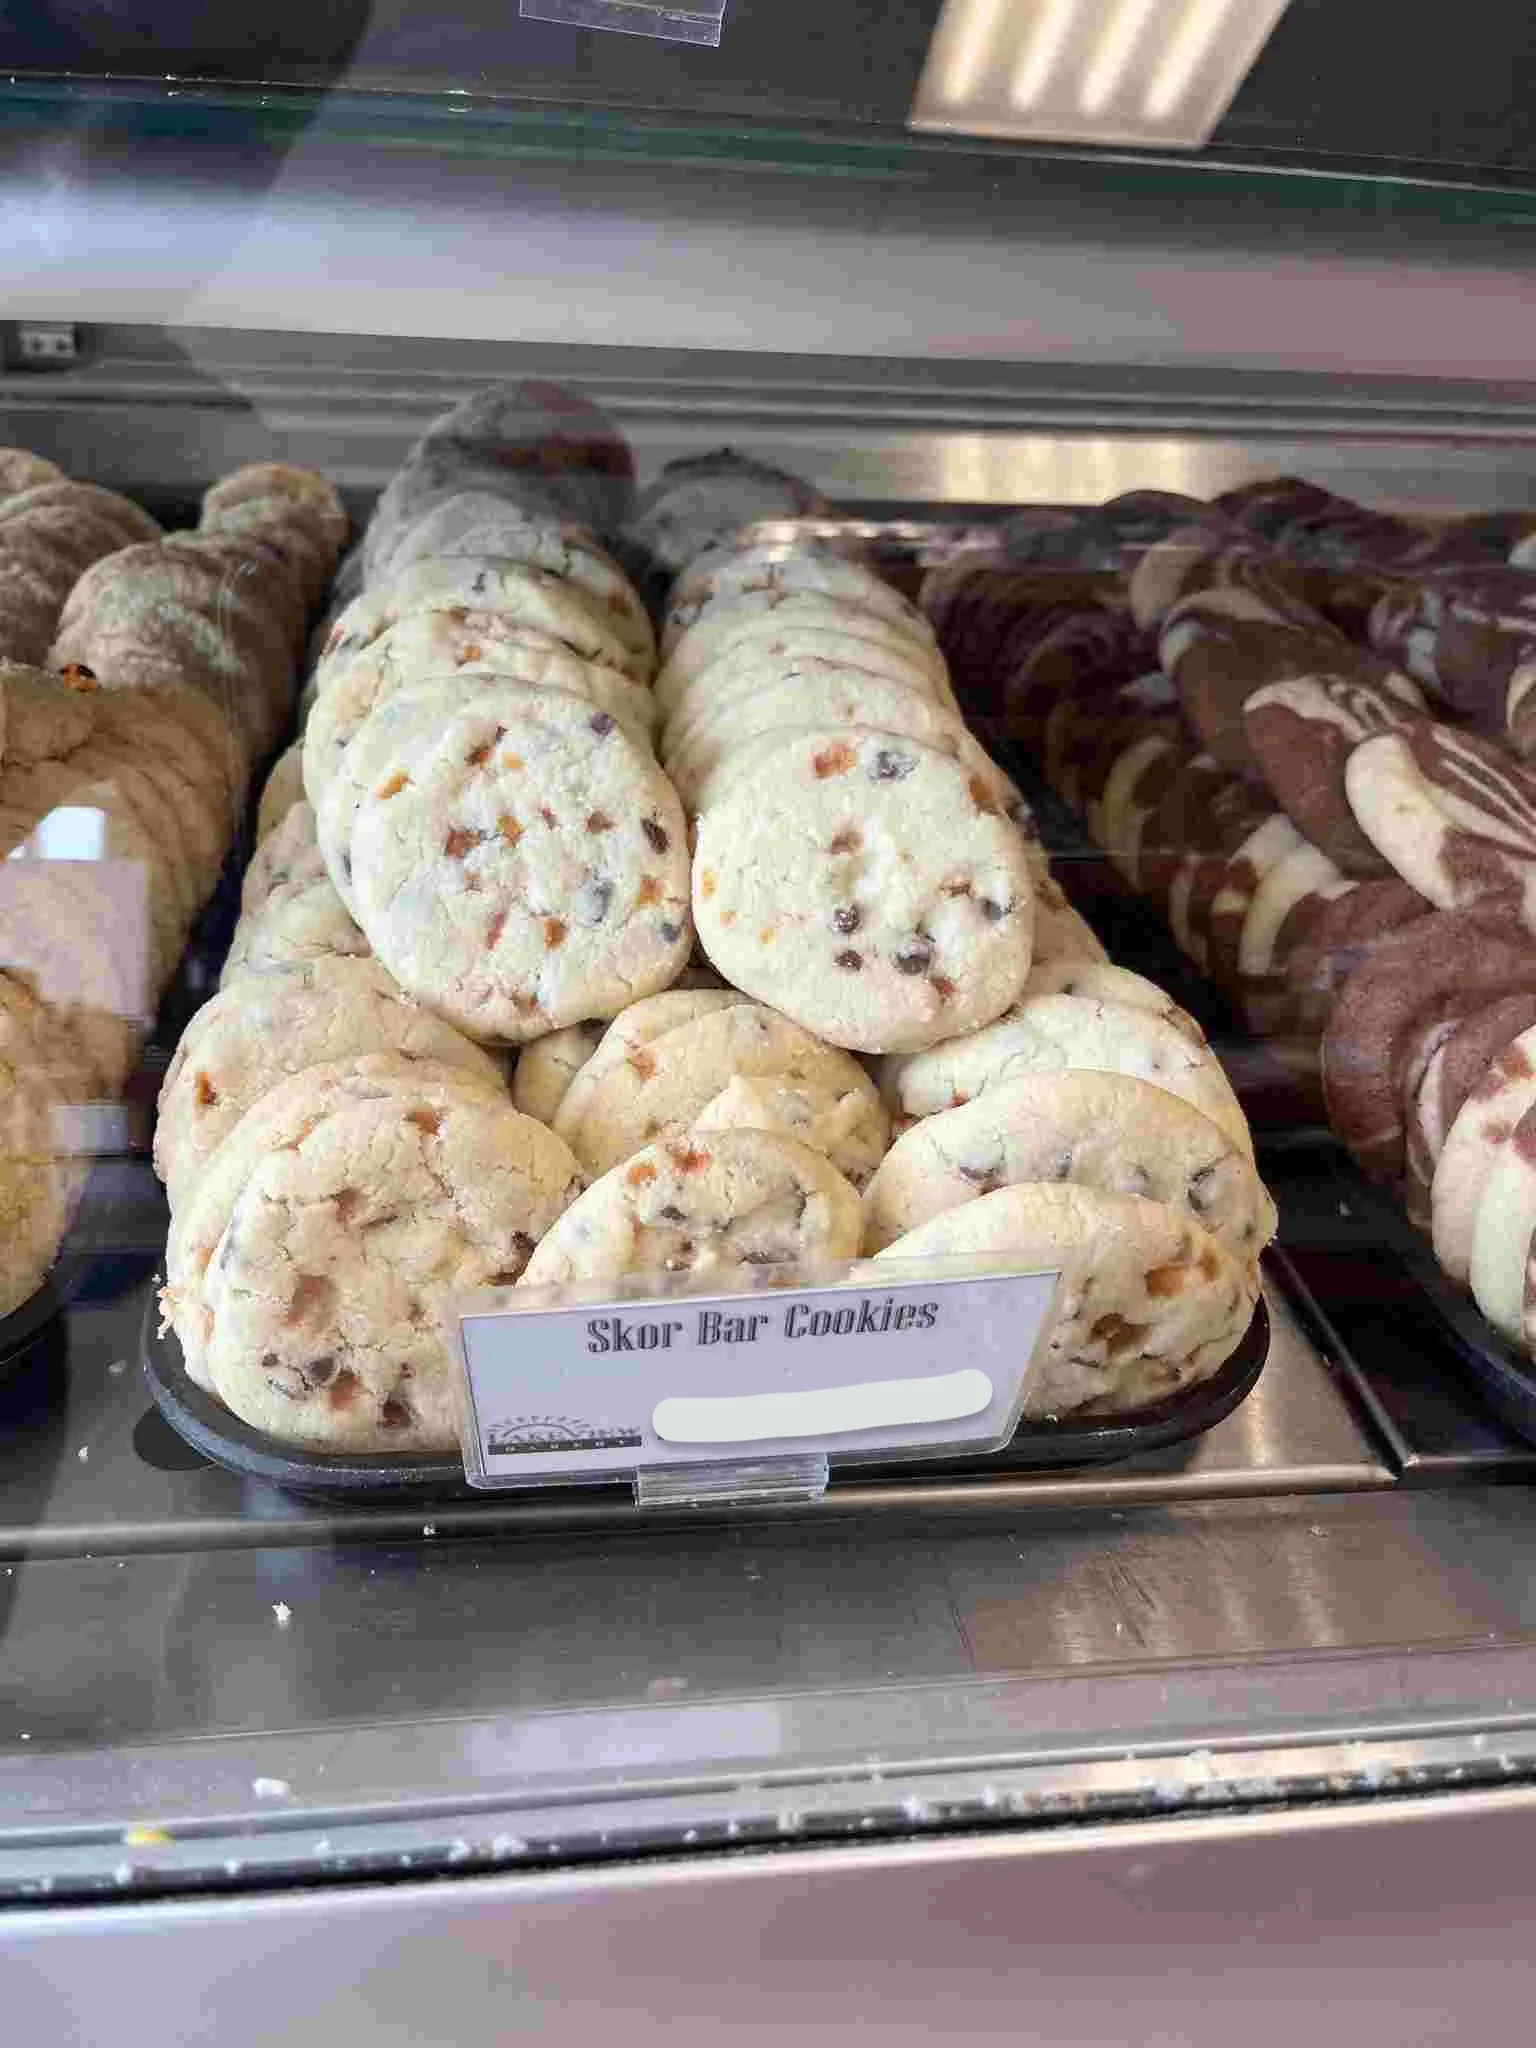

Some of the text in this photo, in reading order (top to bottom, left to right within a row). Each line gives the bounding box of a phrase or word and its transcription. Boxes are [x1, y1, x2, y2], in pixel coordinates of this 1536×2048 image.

[586, 1297, 939, 1353] Skor Bar Cookies
